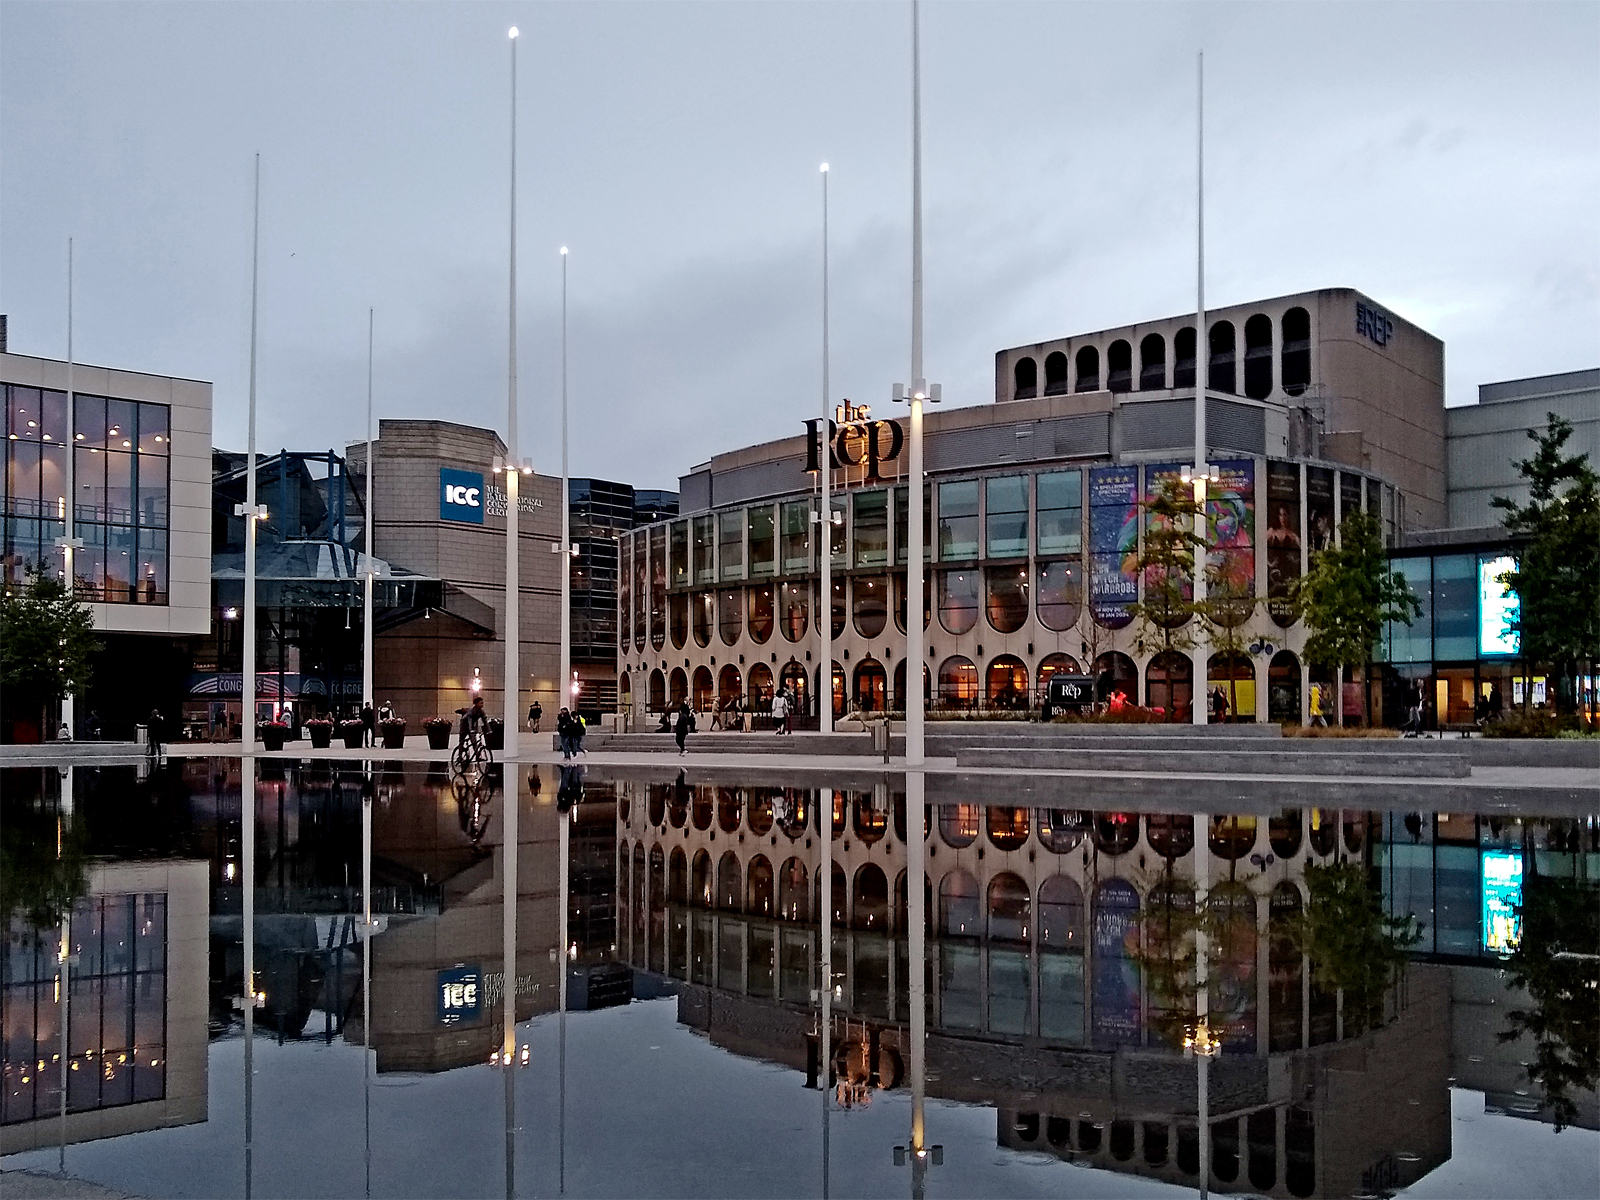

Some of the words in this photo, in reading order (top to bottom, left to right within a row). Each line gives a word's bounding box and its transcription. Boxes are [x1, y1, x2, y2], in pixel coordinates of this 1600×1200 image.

[835, 398, 872, 424] the
[801, 418, 904, 479] Rep
[446, 484, 480, 507] ICC
[1061, 684, 1082, 699] Rep
